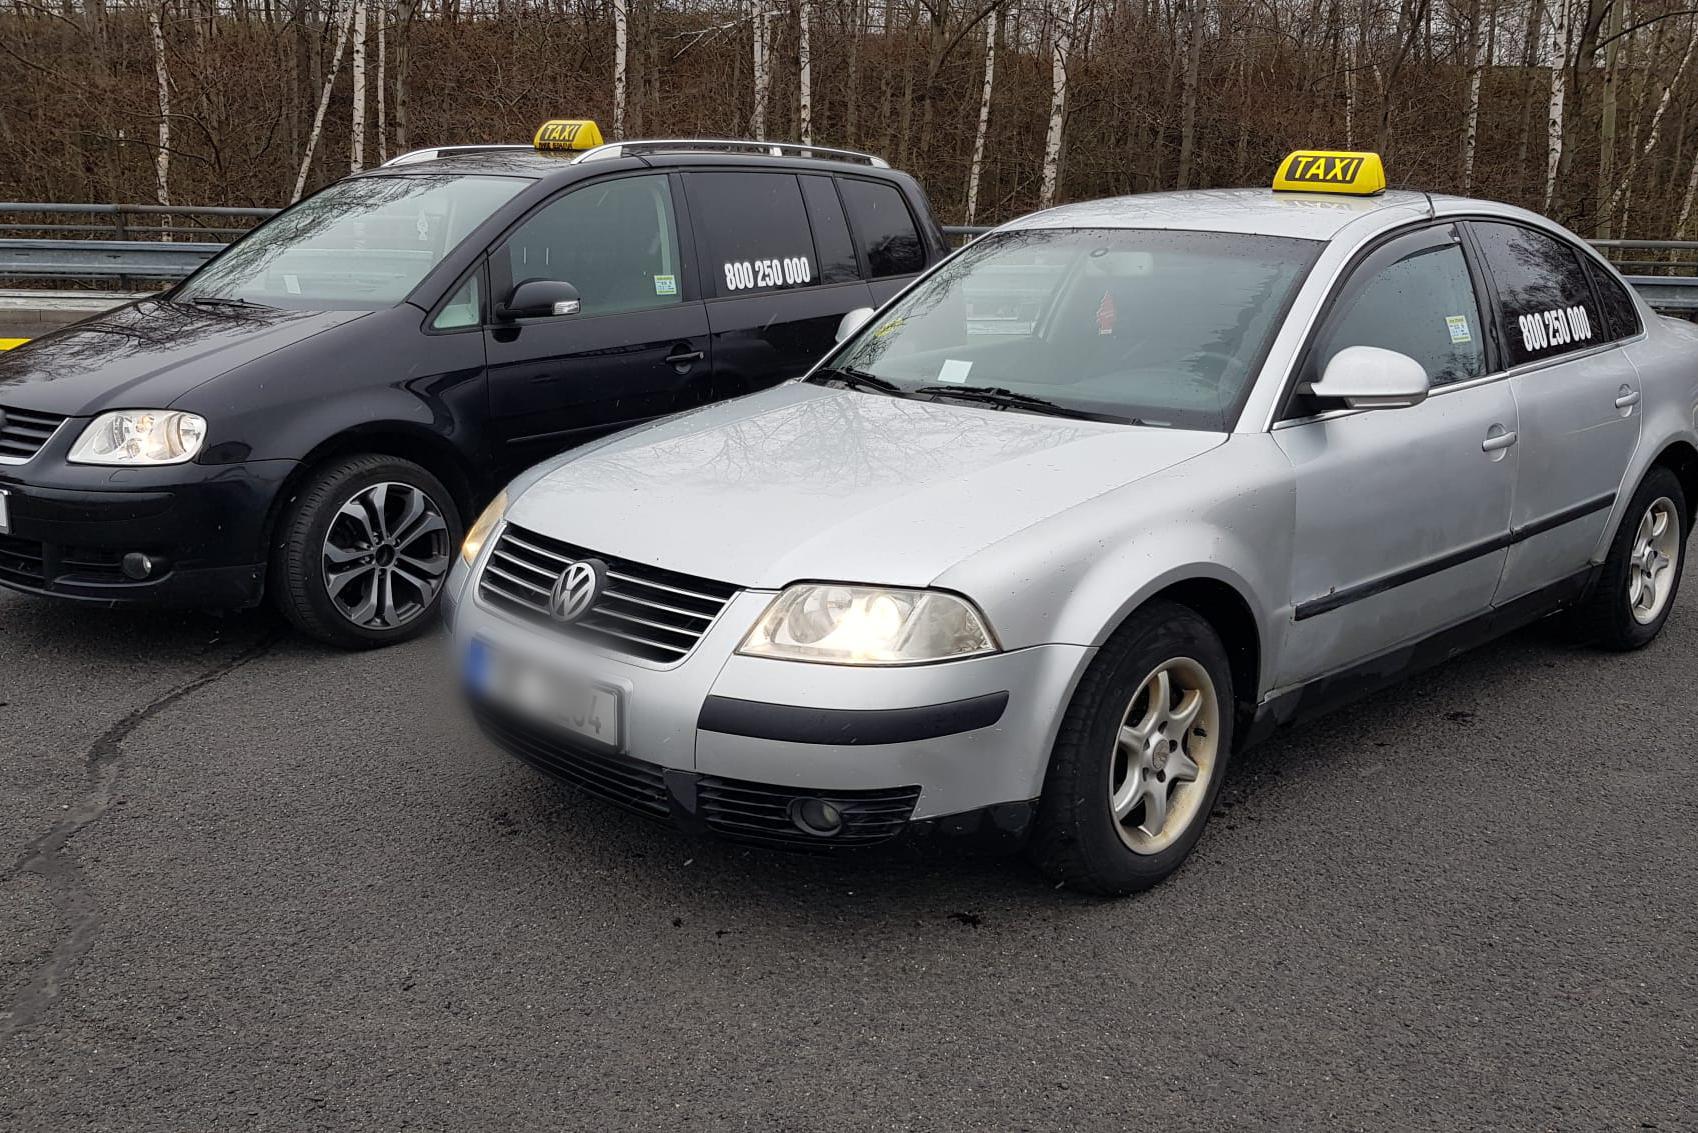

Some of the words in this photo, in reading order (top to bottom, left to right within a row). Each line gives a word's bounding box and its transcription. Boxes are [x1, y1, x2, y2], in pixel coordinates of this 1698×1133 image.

[544, 124, 580, 141] TAXI
[1294, 157, 1360, 181] TAXI
[724, 261, 755, 291] 800
[754, 260, 783, 288] 250
[783, 257, 811, 285] 000
[1518, 315, 1548, 352] 800
[1543, 308, 1571, 347] 250
[1566, 305, 1592, 342] 000
